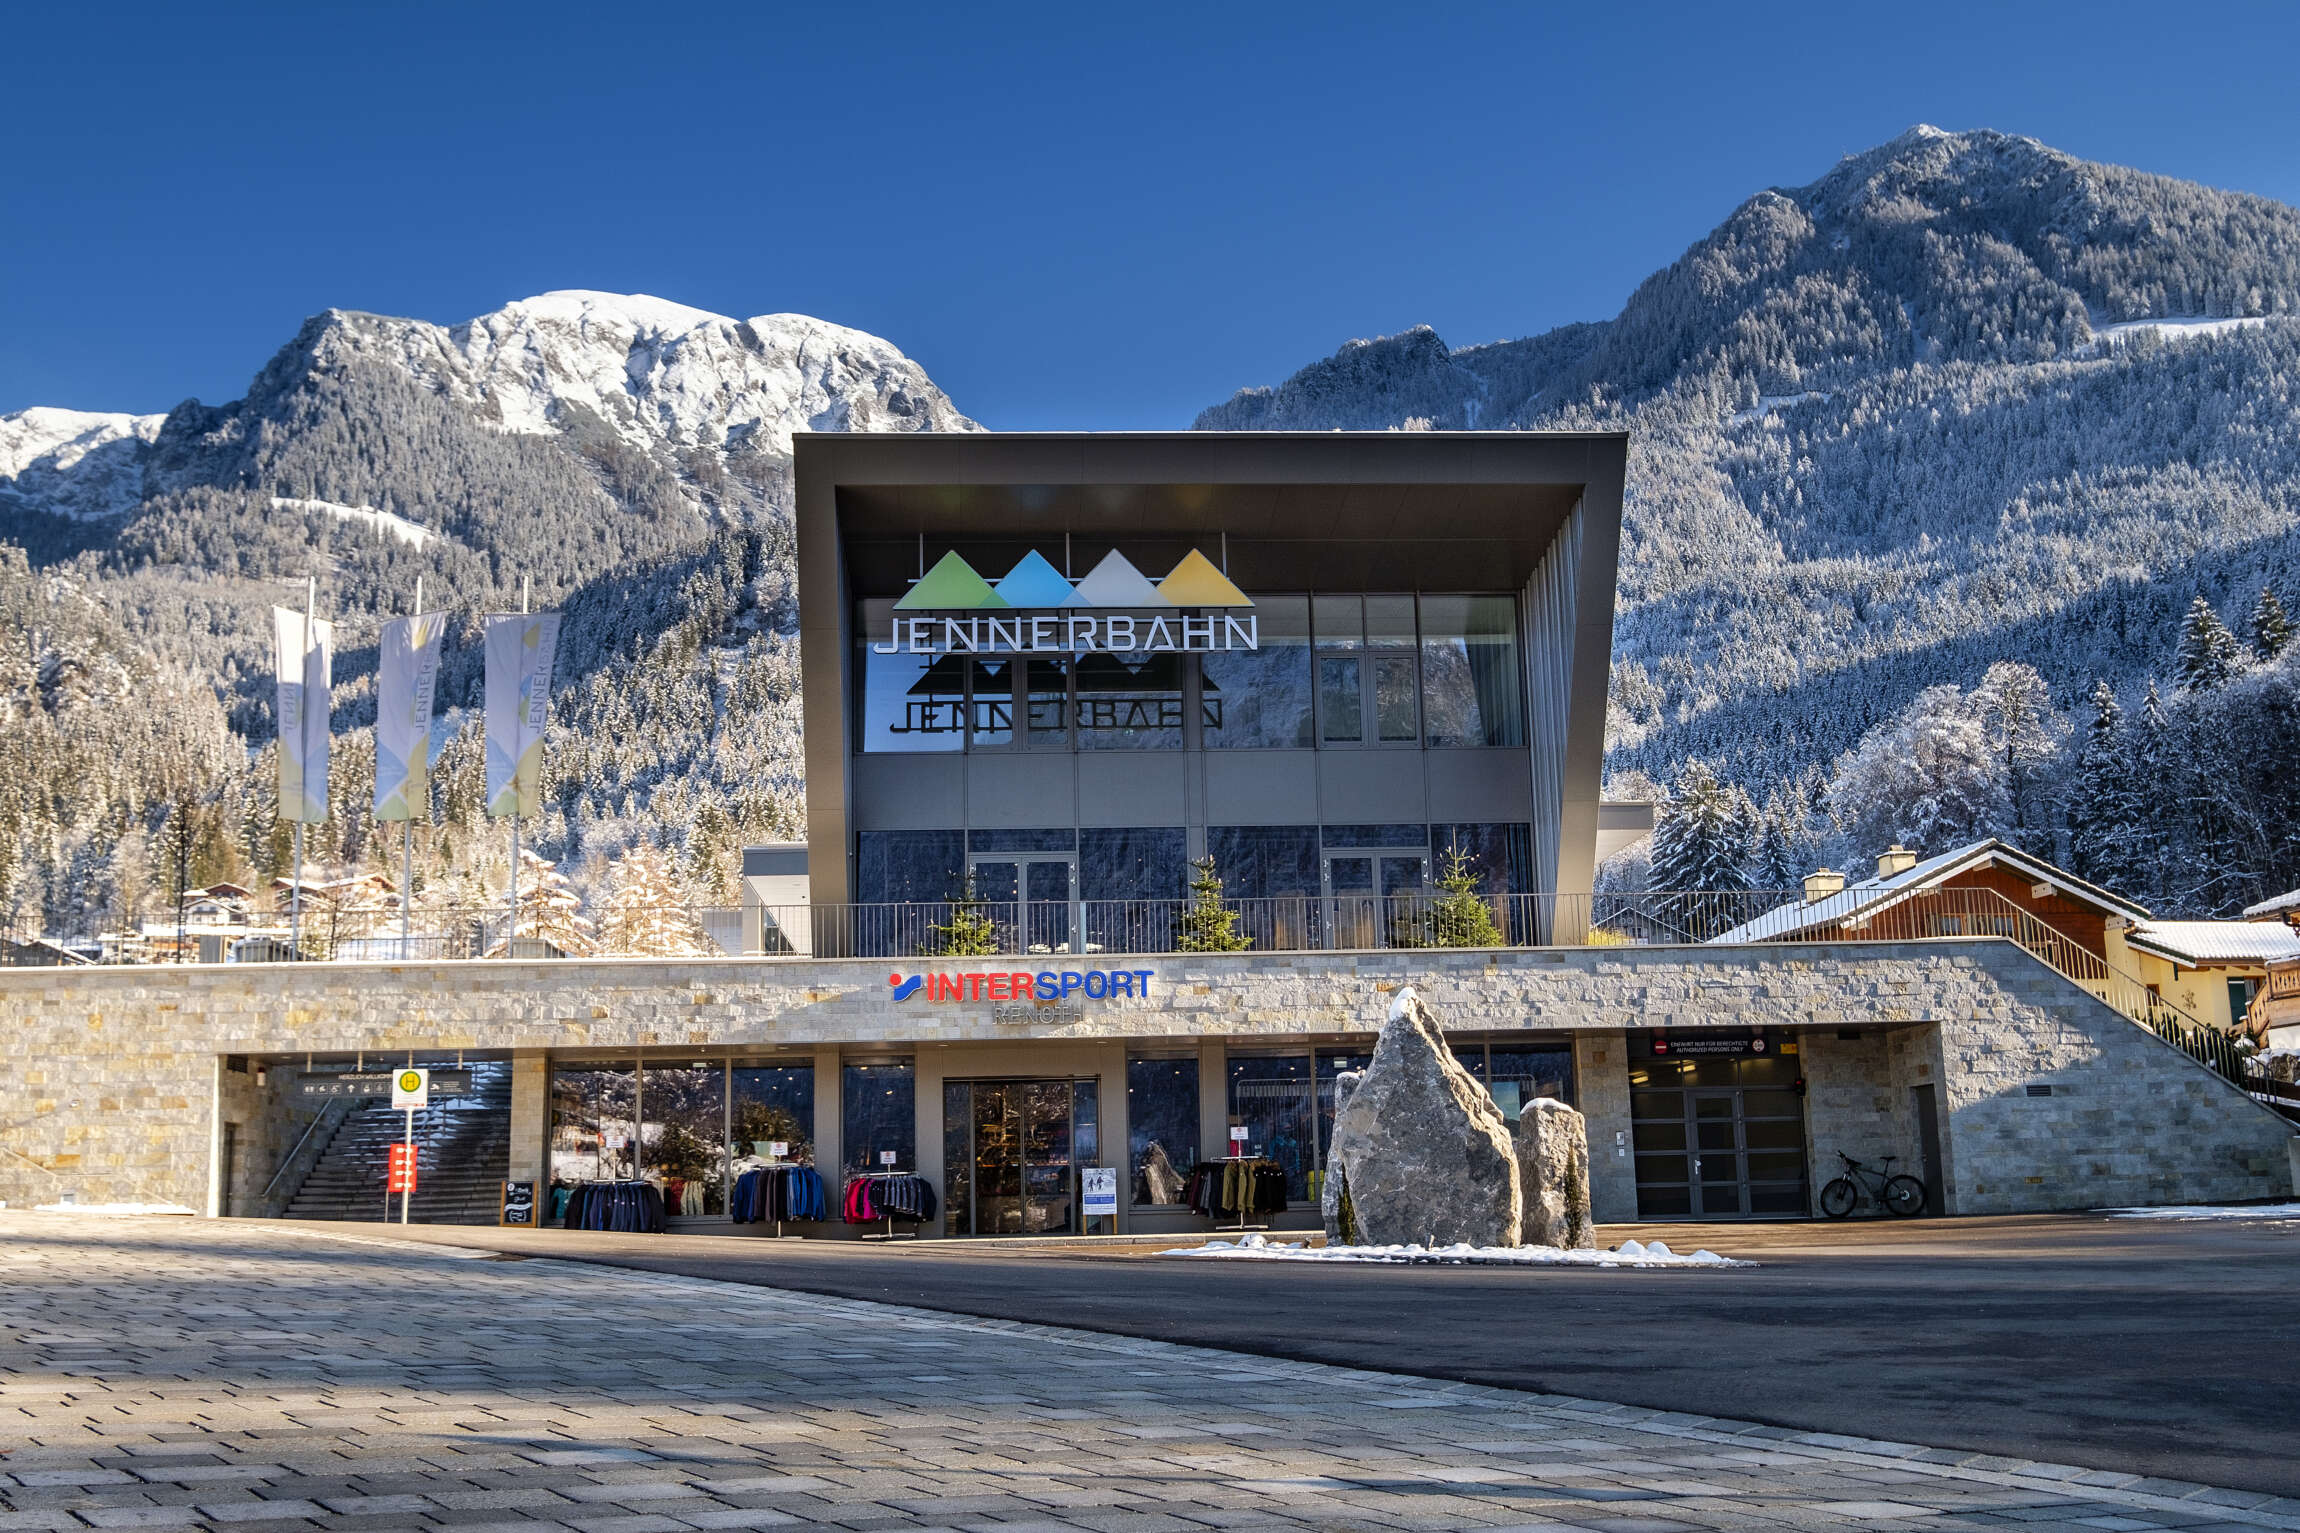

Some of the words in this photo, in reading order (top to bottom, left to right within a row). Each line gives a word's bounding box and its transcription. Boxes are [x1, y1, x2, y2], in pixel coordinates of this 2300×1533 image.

[873, 615, 1257, 654] JENNERBAHN
[927, 970, 1154, 1002] INTERSPORT
[992, 1005, 1085, 1025] RENOTH
[406, 1076, 415, 1088] H
